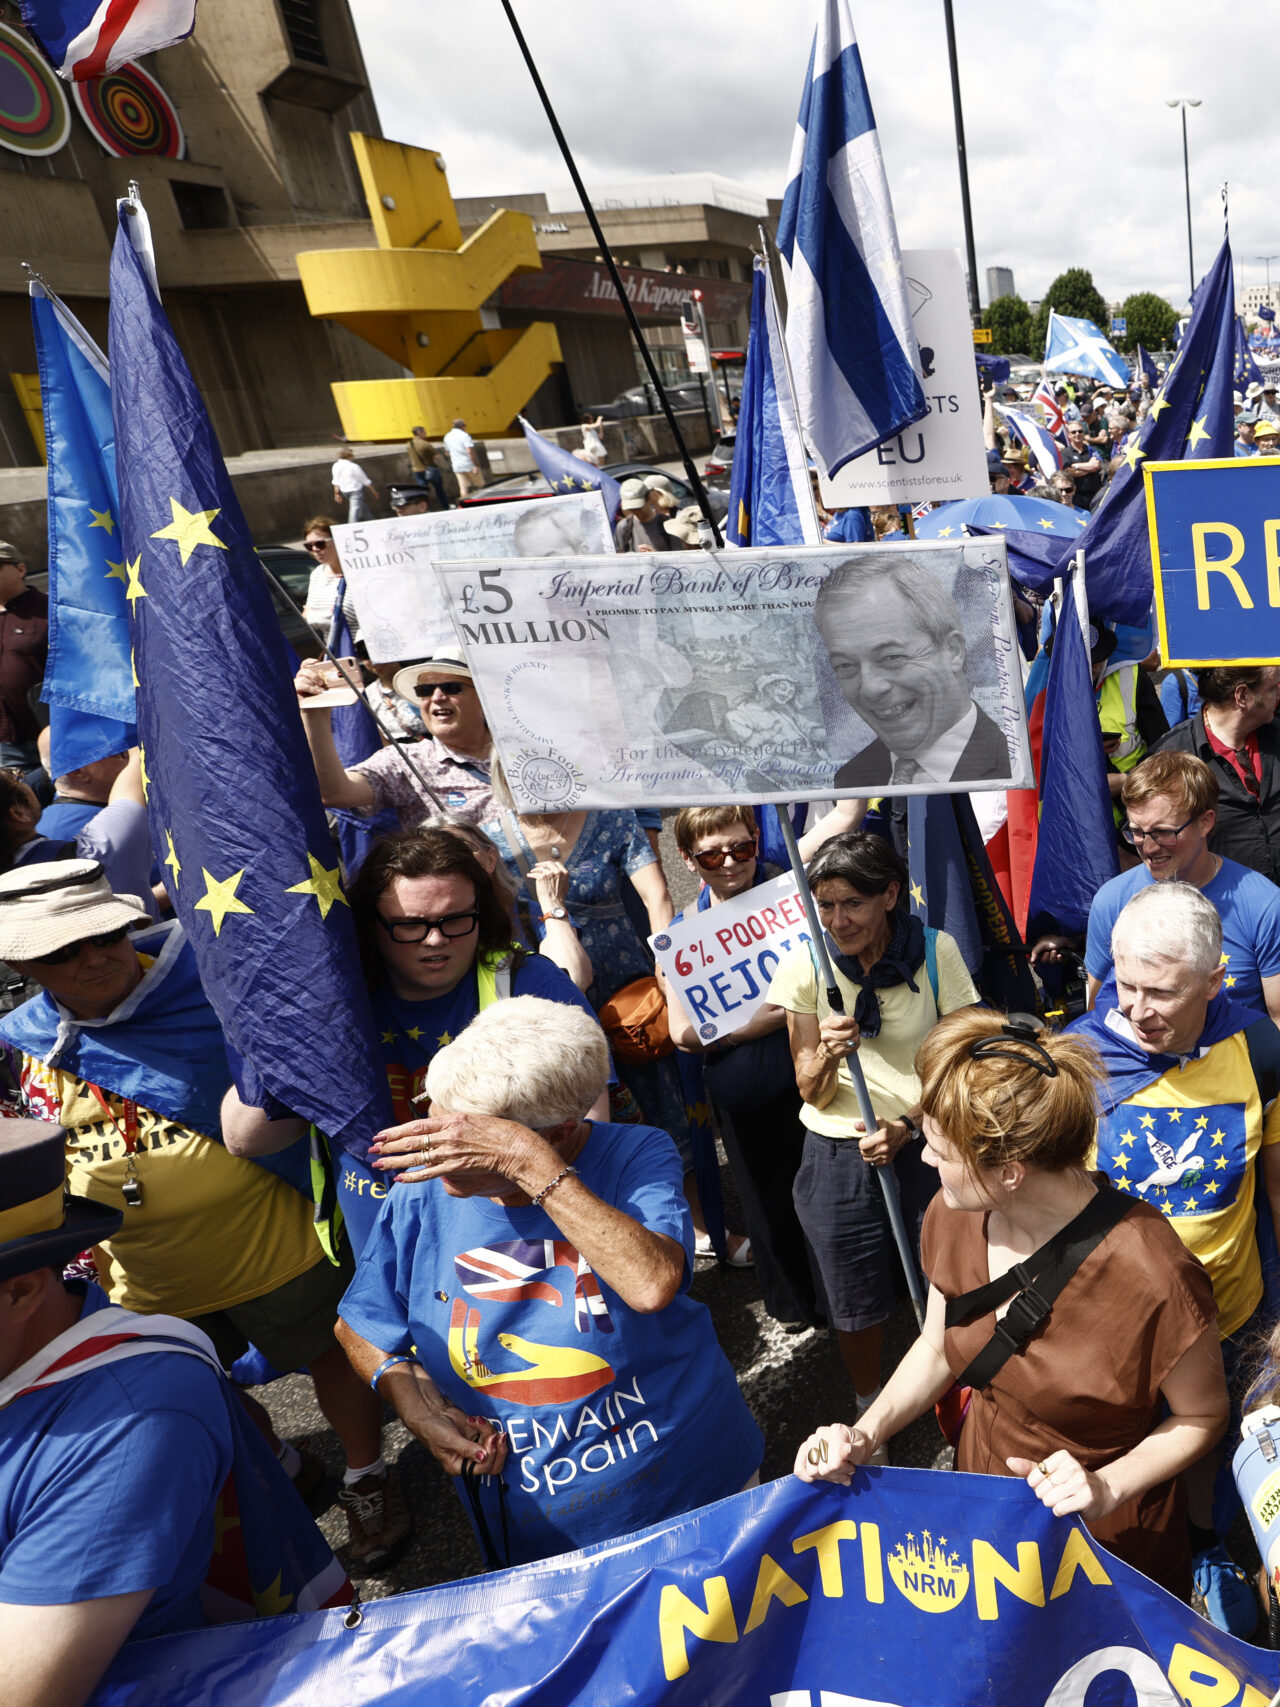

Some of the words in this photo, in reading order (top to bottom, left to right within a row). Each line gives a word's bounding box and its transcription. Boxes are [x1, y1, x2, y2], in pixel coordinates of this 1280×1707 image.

[876, 433, 926, 465] EU
[848, 473, 963, 489] www.scientistsforeu.uk
[344, 551, 416, 571] MILLION
[459, 568, 513, 615] £5
[538, 570, 644, 607] Imperial
[650, 565, 727, 597] Bank
[729, 564, 754, 600] of
[595, 608, 643, 616] PROMISE
[643, 607, 658, 615] TO
[660, 606, 681, 614] PAY
[683, 605, 724, 613] MYSELF
[726, 603, 758, 612] MORE
[761, 602, 790, 610] THAN
[791, 601, 815, 609] YOU
[459, 618, 611, 646] MILLION
[510, 661, 549, 675] BREXIT
[507, 748, 539, 779] Banks
[548, 747, 584, 778] Food
[616, 746, 649, 764] For
[656, 743, 685, 761] the
[512, 784, 547, 813] Food
[553, 782, 587, 812] Banks
[674, 940, 714, 977] 6%
[1151, 1140, 1177, 1170] PEACE
[344, 1169, 388, 1199] #re
[520, 1418, 659, 1496] Spain
[903, 1569, 957, 1600] NRM
[658, 1519, 1113, 1681] NATIONA
